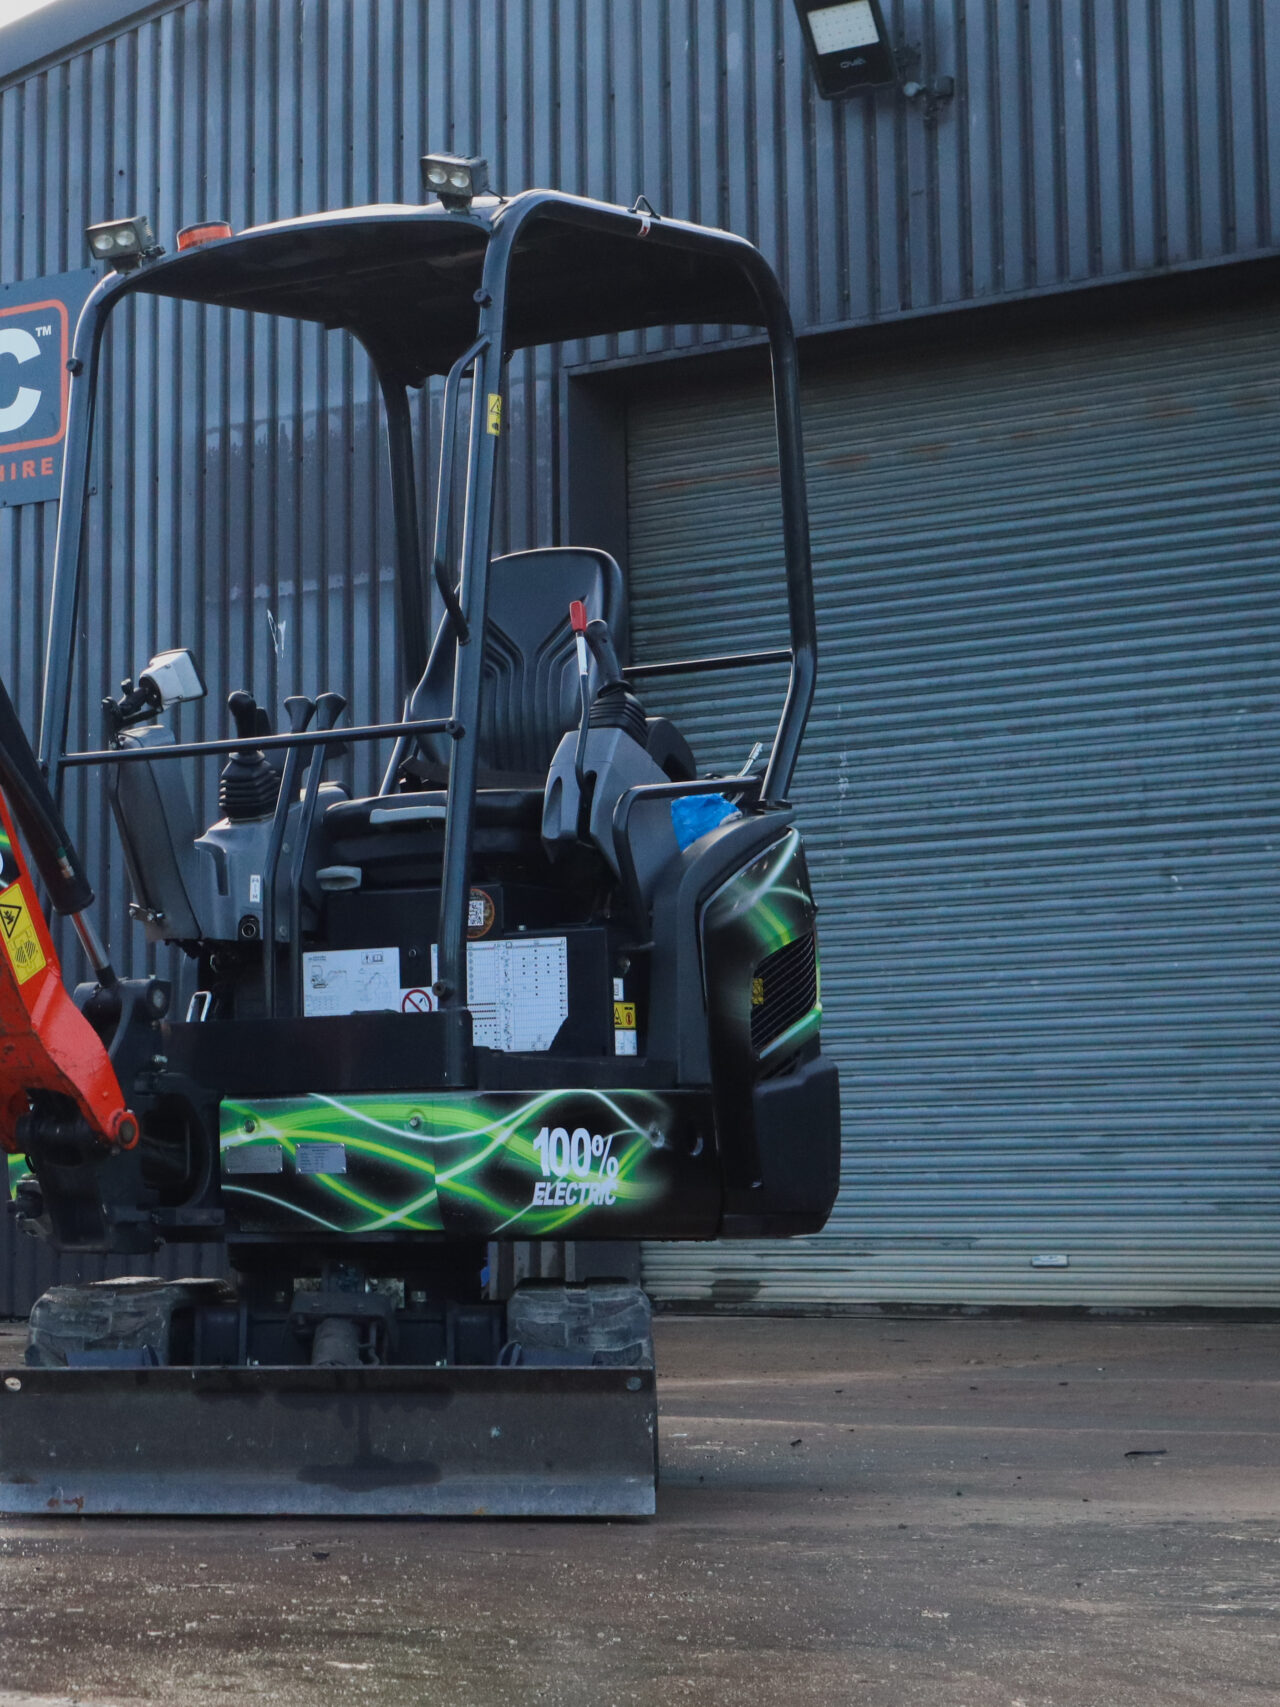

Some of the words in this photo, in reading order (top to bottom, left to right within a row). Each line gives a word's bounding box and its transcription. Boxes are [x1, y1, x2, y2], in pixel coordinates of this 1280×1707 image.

[35, 325, 52, 337] TM
[533, 1127, 619, 1178] 100%
[532, 1181, 619, 1206] ELECTRIC
